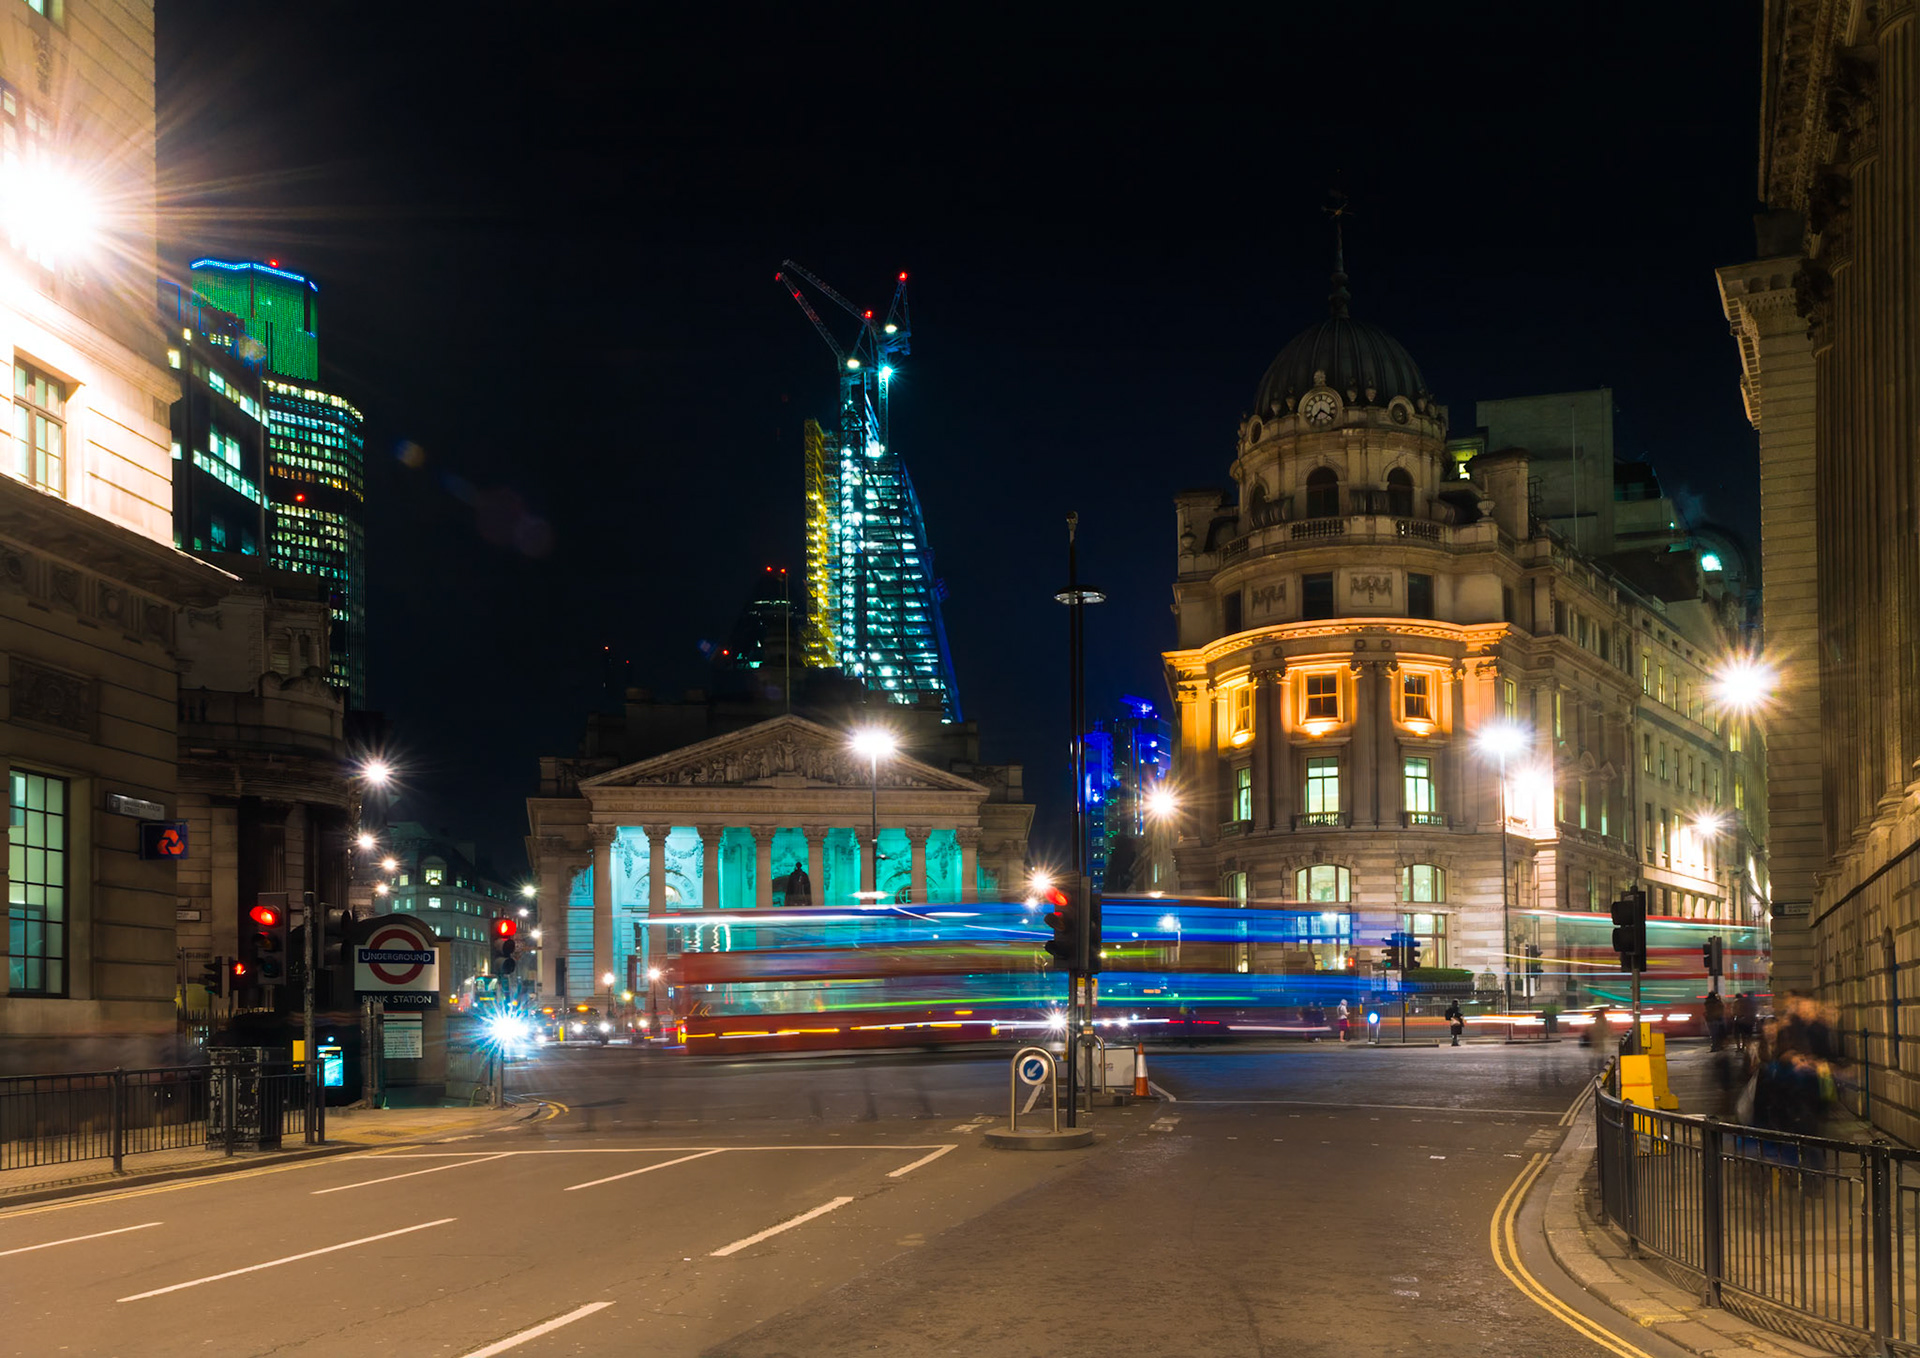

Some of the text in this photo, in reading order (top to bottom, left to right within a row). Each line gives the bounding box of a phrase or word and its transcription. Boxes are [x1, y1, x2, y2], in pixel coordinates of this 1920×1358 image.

[361, 951, 432, 962] UNDERGROUND
[362, 995, 432, 1004] BANK STATION
